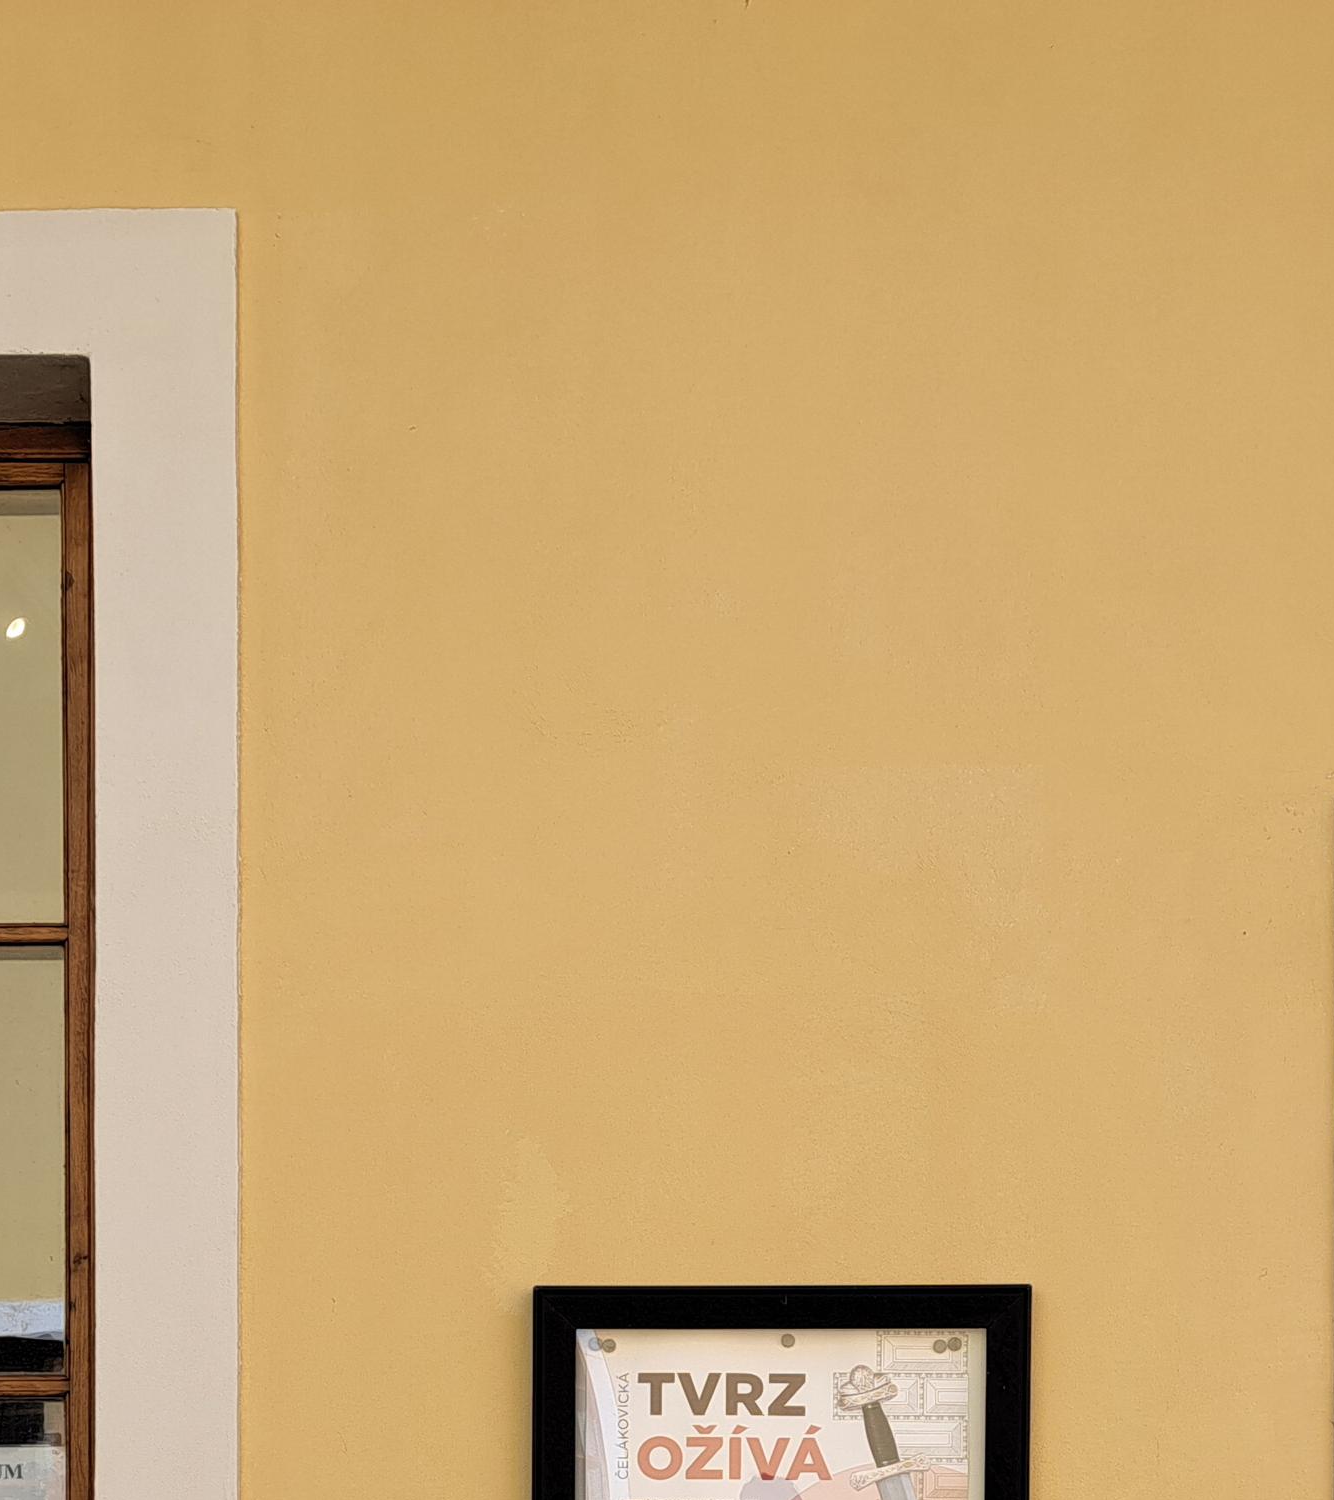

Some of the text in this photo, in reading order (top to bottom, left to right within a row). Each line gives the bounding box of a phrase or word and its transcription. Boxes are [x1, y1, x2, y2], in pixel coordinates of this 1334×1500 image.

[637, 1372, 807, 1417] TVRZ
[615, 1372, 630, 1480] ČELÁKOVICKÁ
[637, 1424, 833, 1481] OŽÍVÁ
